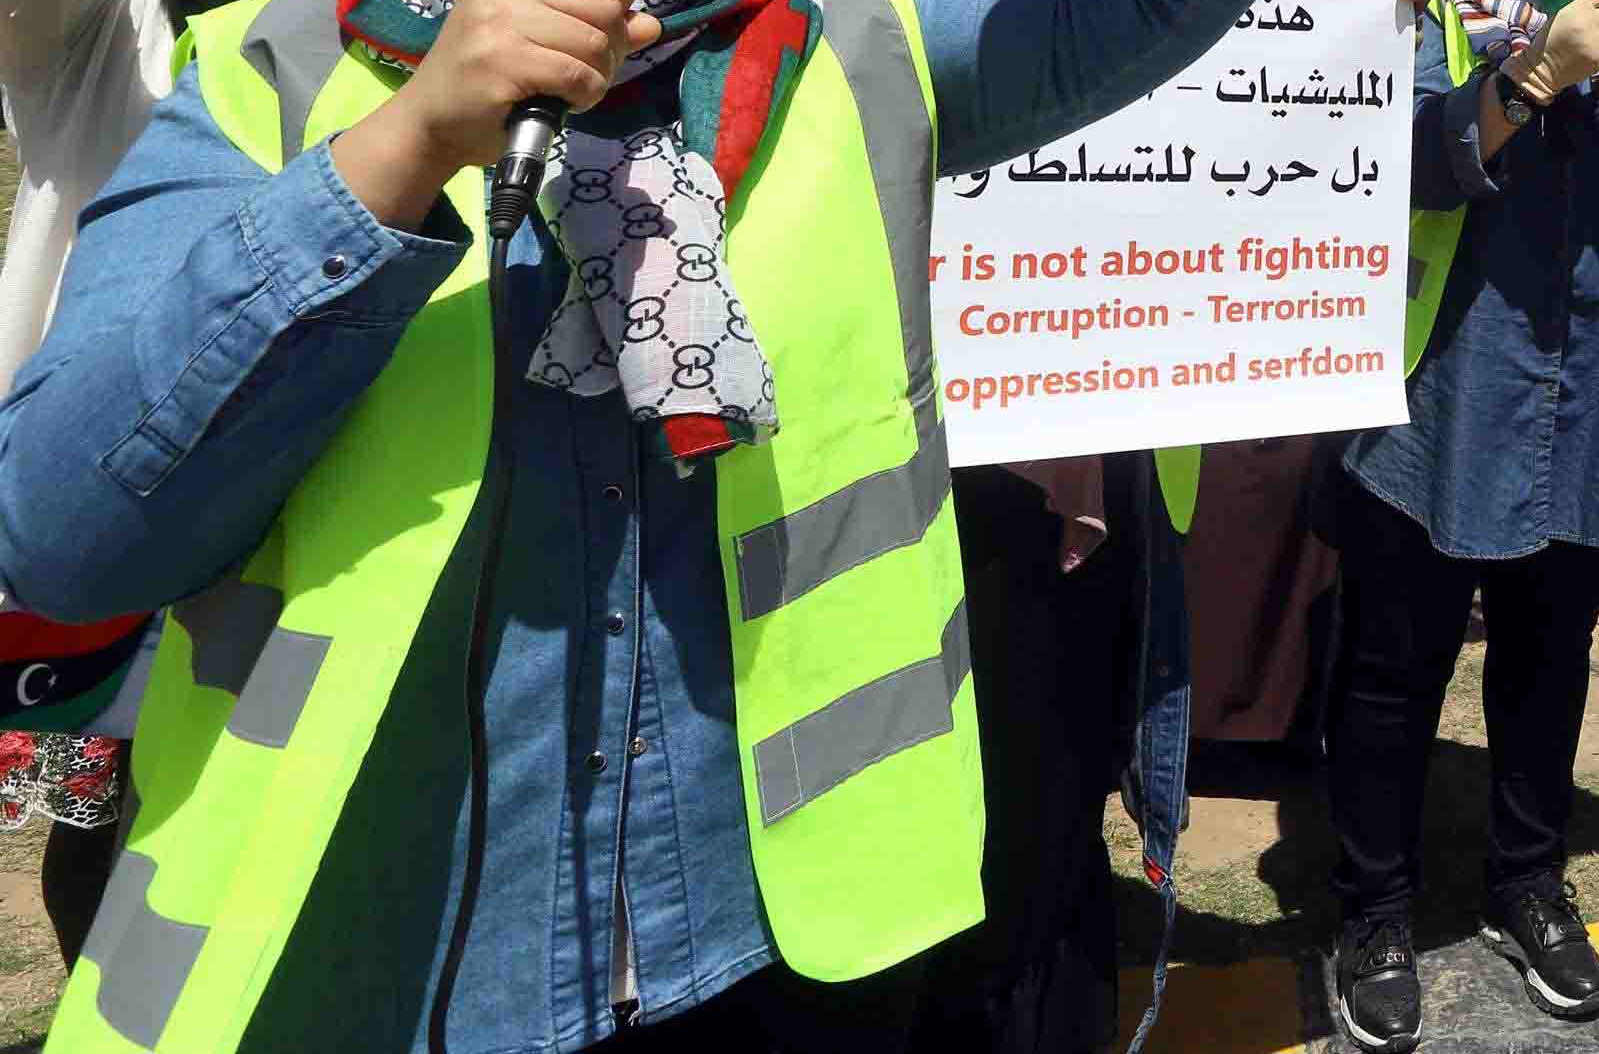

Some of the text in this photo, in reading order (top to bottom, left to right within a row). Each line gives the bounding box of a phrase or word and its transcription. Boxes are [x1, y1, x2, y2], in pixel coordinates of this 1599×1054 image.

[1215, 65, 1394, 119] المليشيات
[1007, 141, 1198, 183] للتسلط
[1210, 155, 1319, 197] حرب
[1331, 146, 1379, 197] بل
[961, 243, 996, 282] is
[1011, 245, 1088, 279] not
[1101, 241, 1224, 277] about
[1238, 236, 1390, 282] fighting
[958, 298, 1169, 340] Corruption
[1207, 290, 1367, 325] Terrorism
[944, 346, 1386, 410] oppression and serfdom
